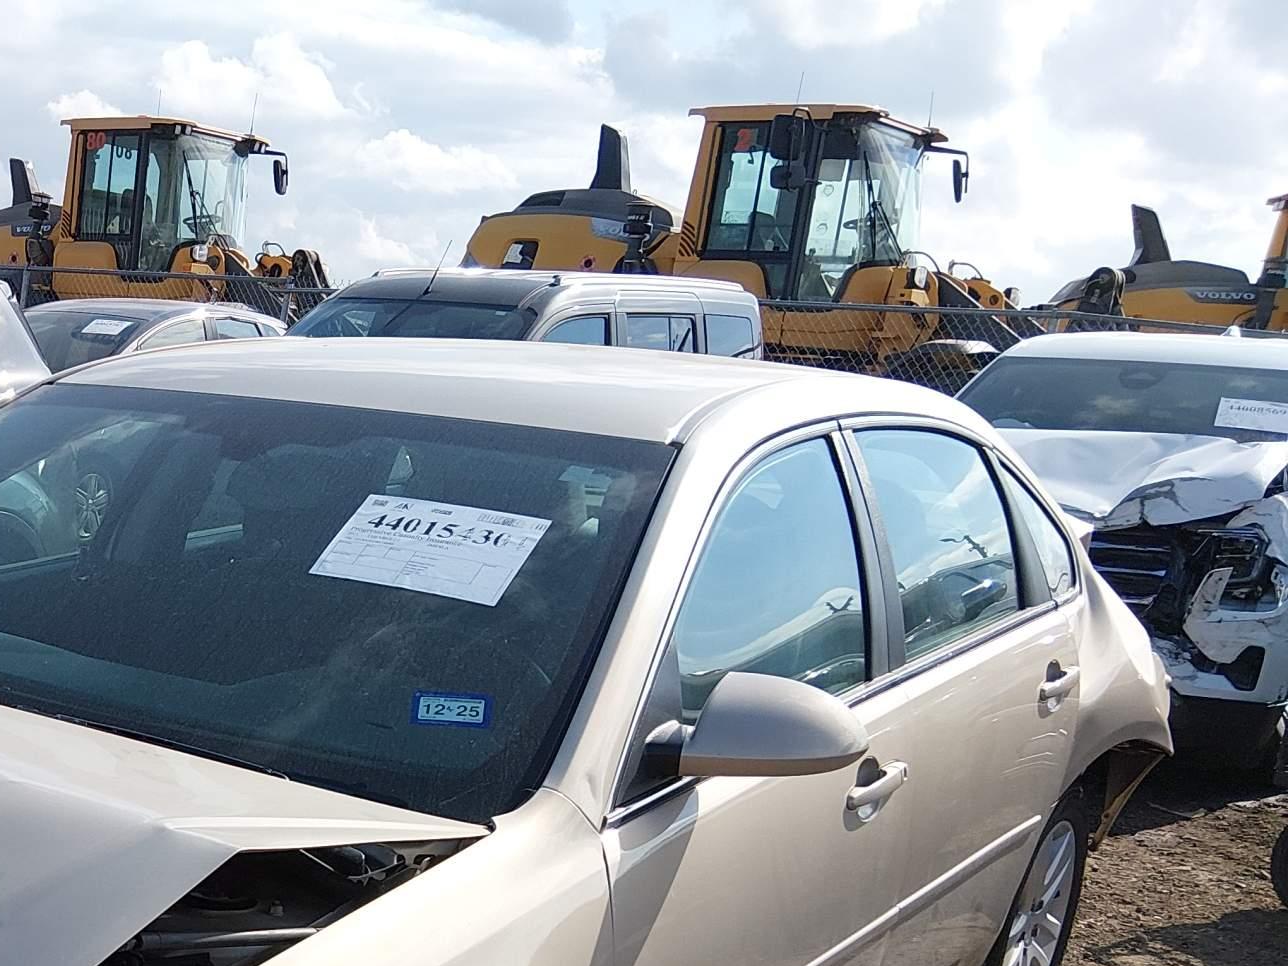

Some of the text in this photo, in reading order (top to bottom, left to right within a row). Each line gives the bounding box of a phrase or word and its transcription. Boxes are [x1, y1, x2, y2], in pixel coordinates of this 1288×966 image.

[87, 131, 106, 150] 80
[16, 224, 51, 233] VOO
[1196, 291, 1256, 300] VOLVO
[423, 703, 480, 718] 12 25
